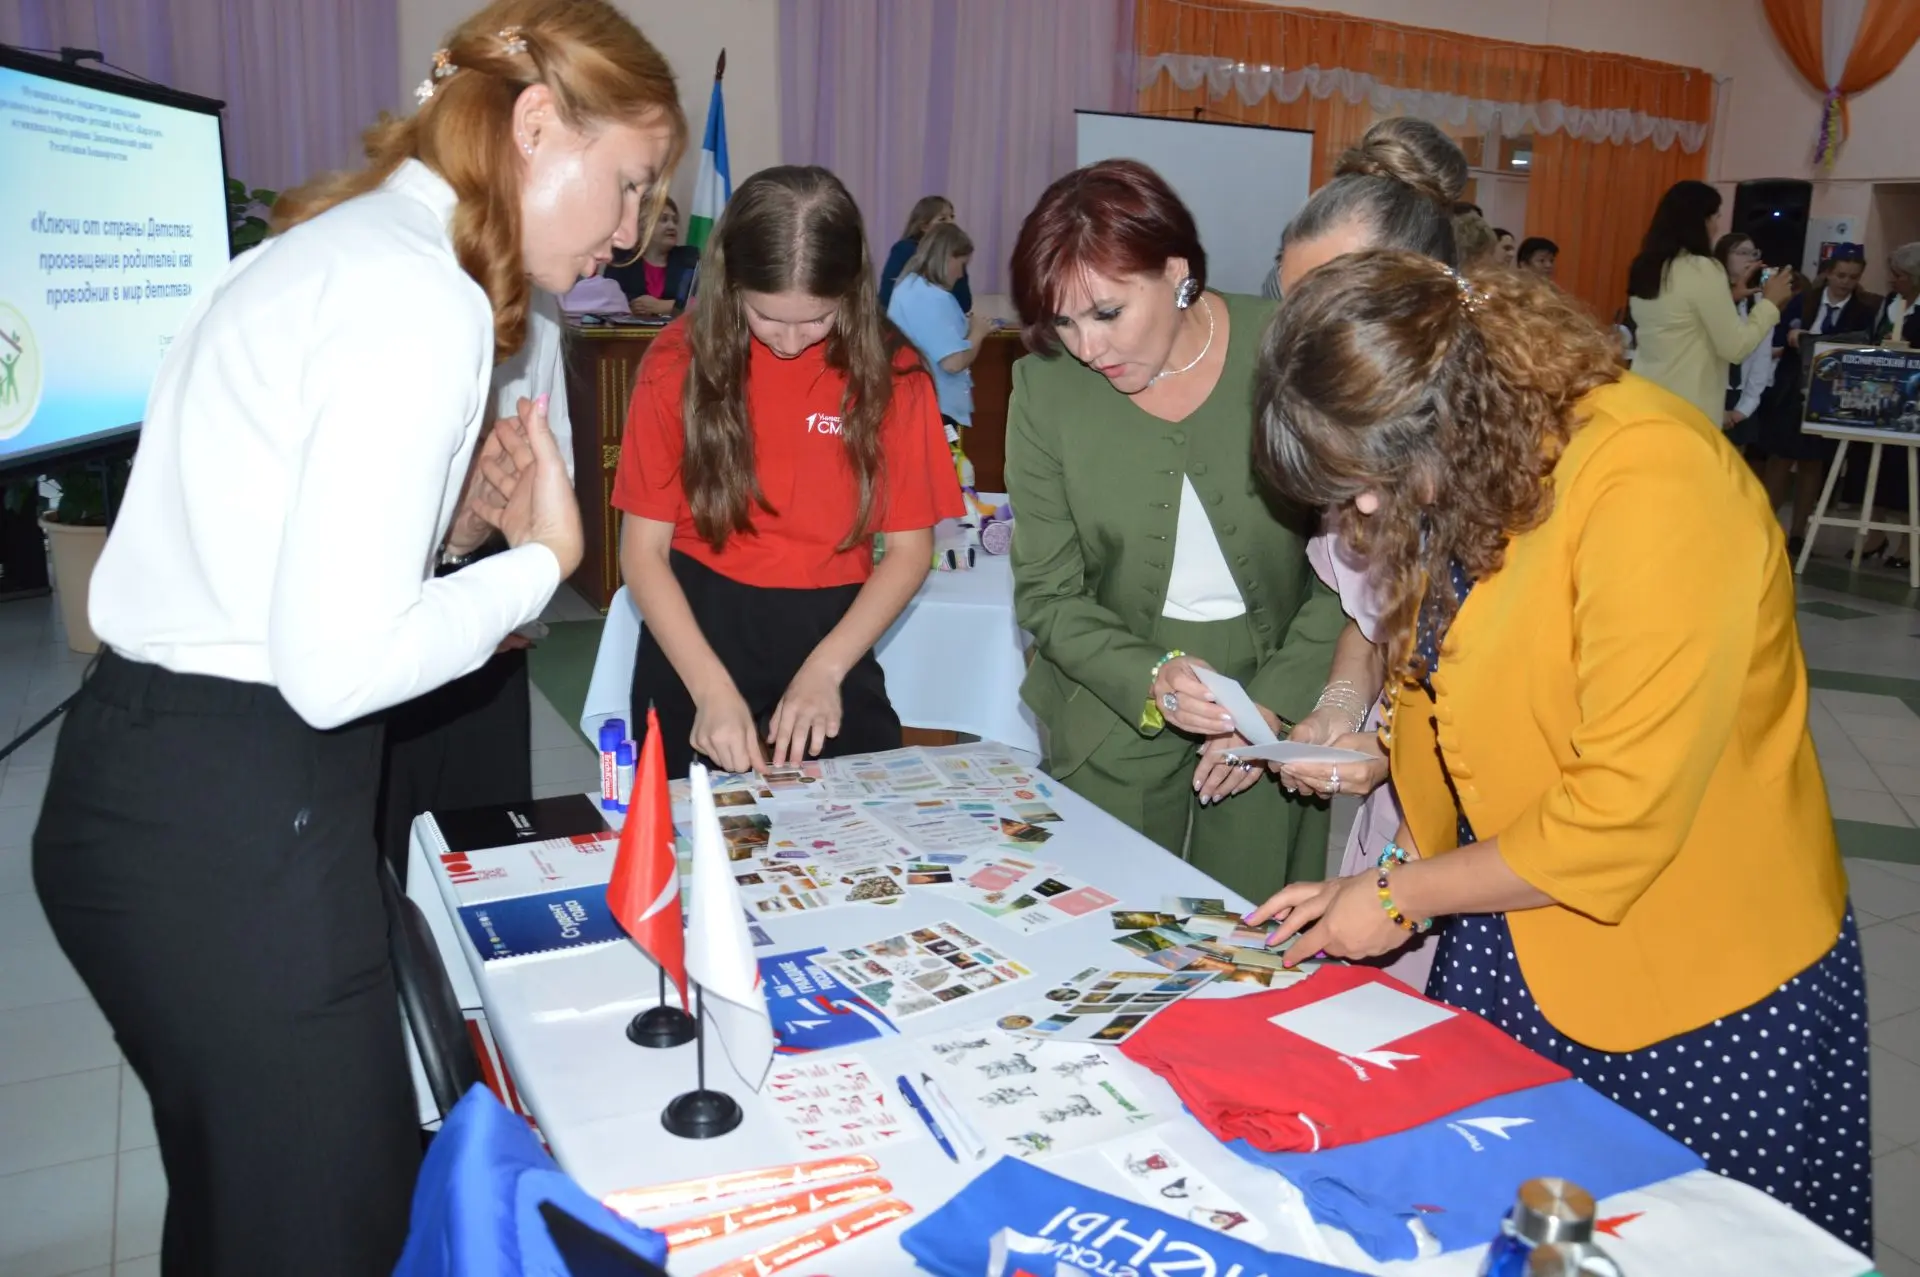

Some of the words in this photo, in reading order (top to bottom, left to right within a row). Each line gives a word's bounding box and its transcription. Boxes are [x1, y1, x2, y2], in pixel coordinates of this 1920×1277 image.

[83, 220, 99, 236] от
[104, 221, 144, 240] страны
[39, 253, 120, 275] просвещение
[123, 249, 176, 273] родителей
[179, 255, 193, 267] как
[46, 281, 110, 310] проводник
[113, 285, 119, 300] в
[122, 284, 142, 303] мир
[818, 421, 843, 435] СМ
